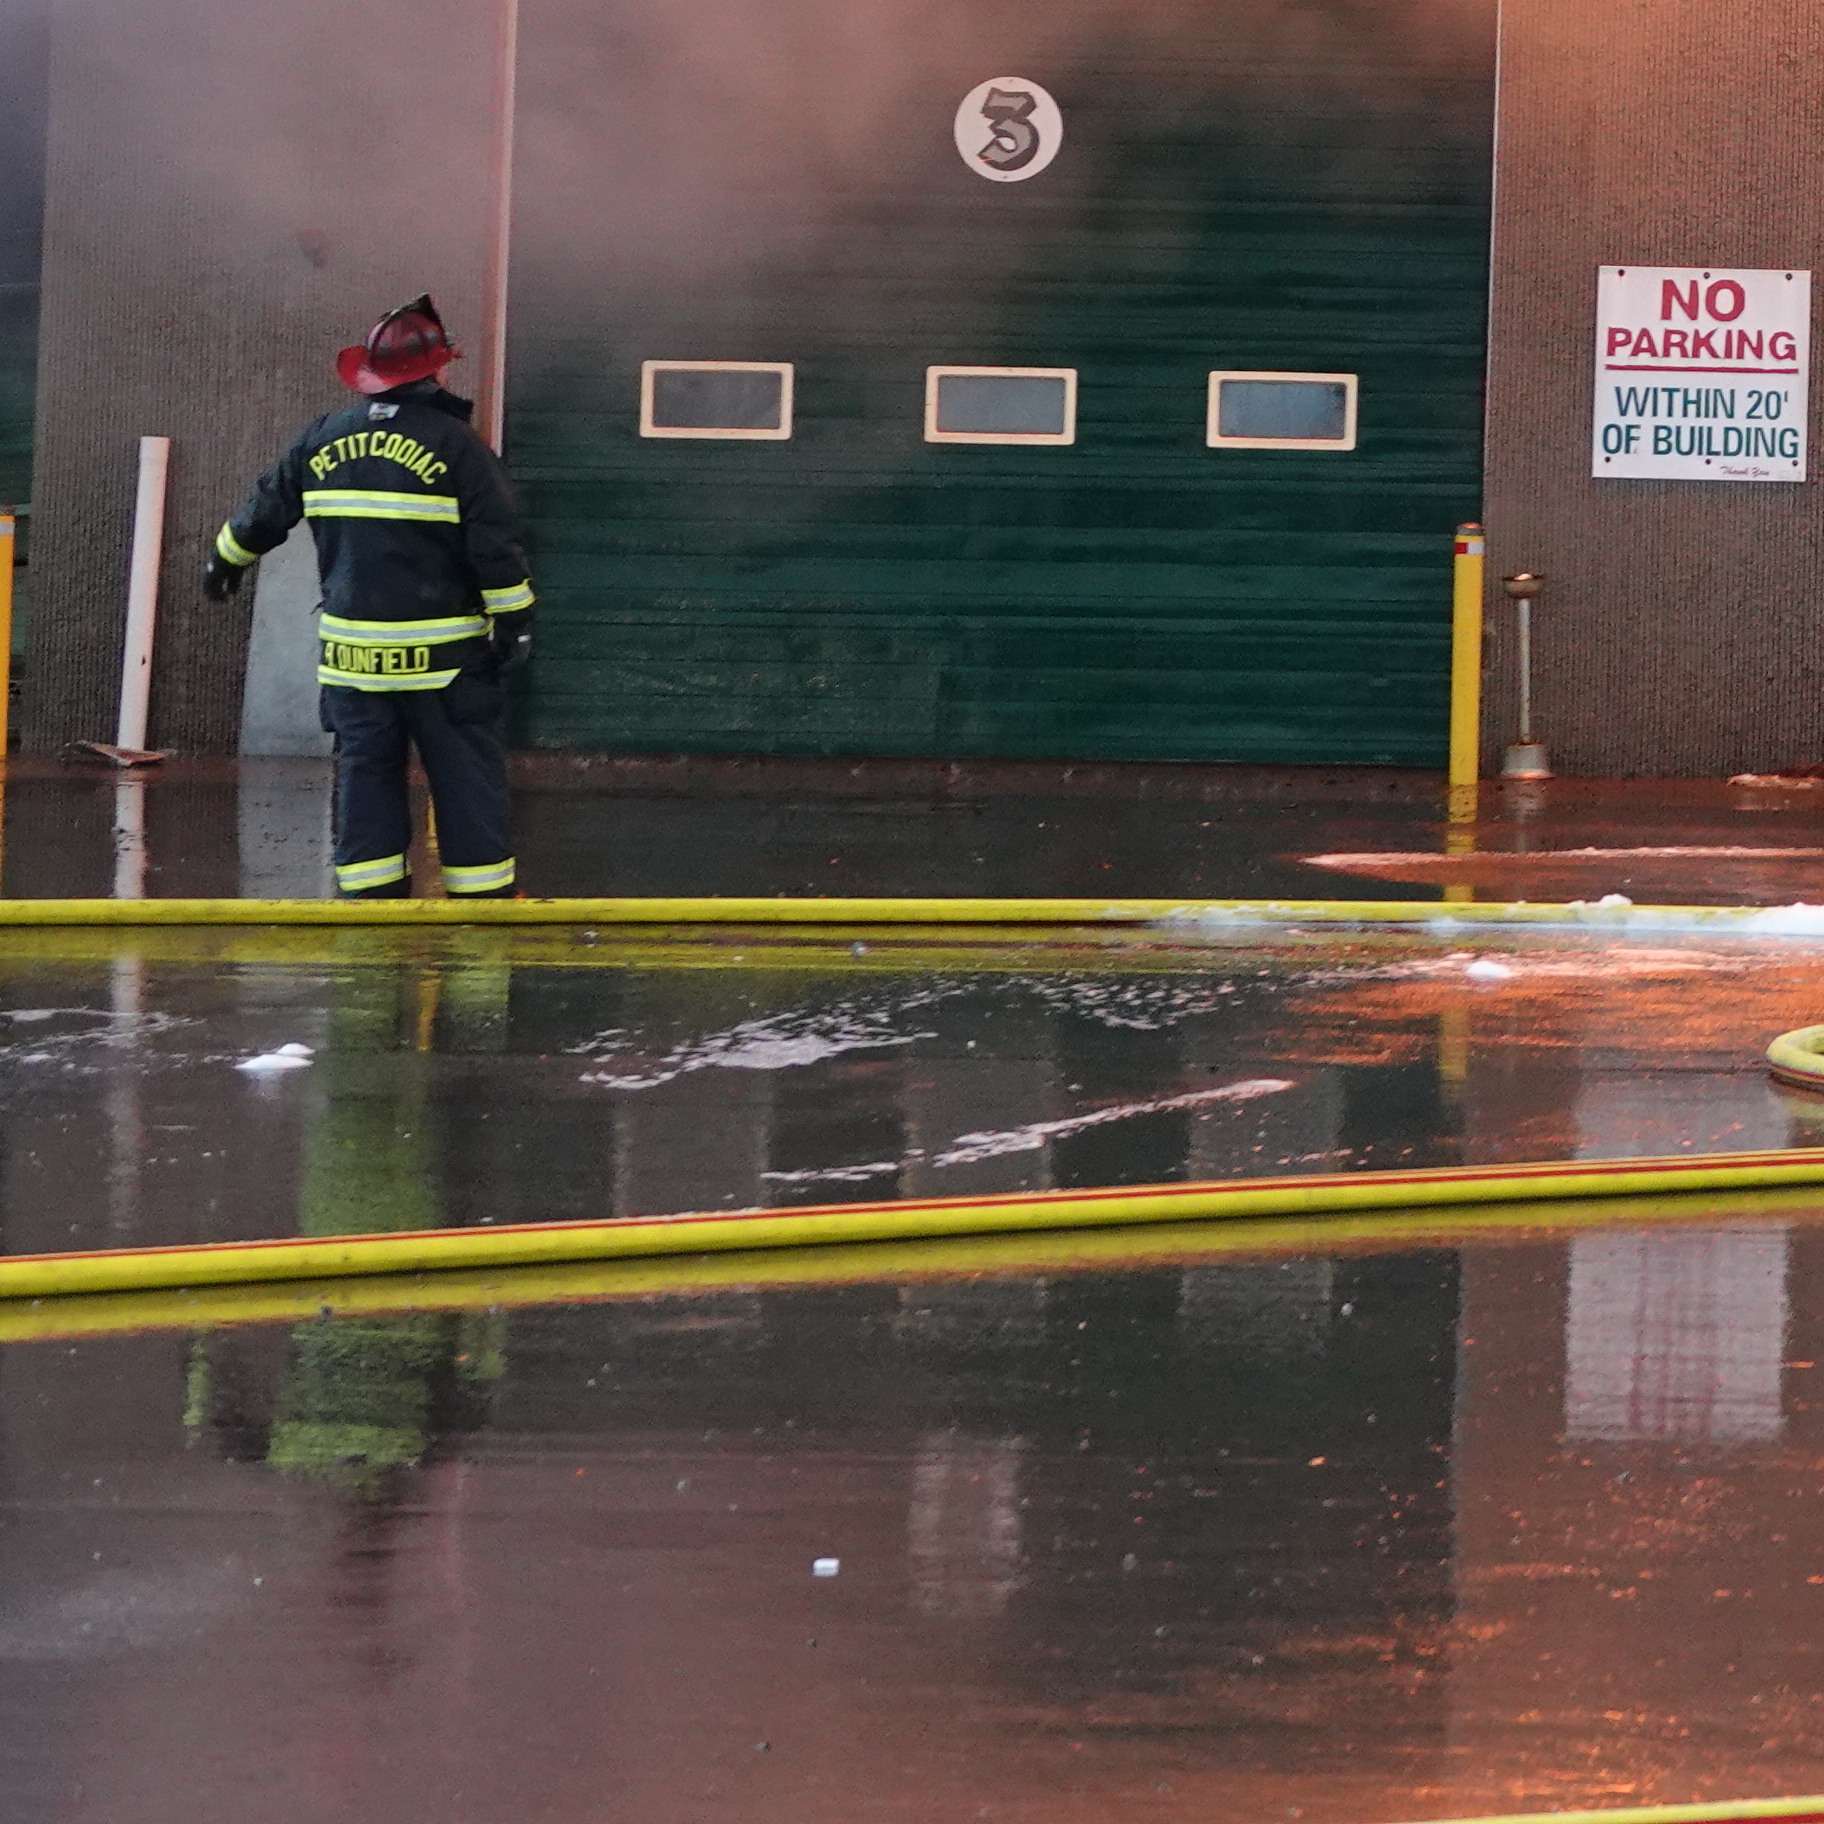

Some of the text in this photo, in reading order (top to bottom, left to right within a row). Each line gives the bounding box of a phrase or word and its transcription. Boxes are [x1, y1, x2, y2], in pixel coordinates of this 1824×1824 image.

[1660, 279, 1745, 322] NO
[1606, 326, 1797, 361] PARKING
[1615, 386, 1736, 419] WITHIN
[308, 430, 448, 485] PETITCODIAC
[1602, 423, 1798, 458] OF BUILDING
